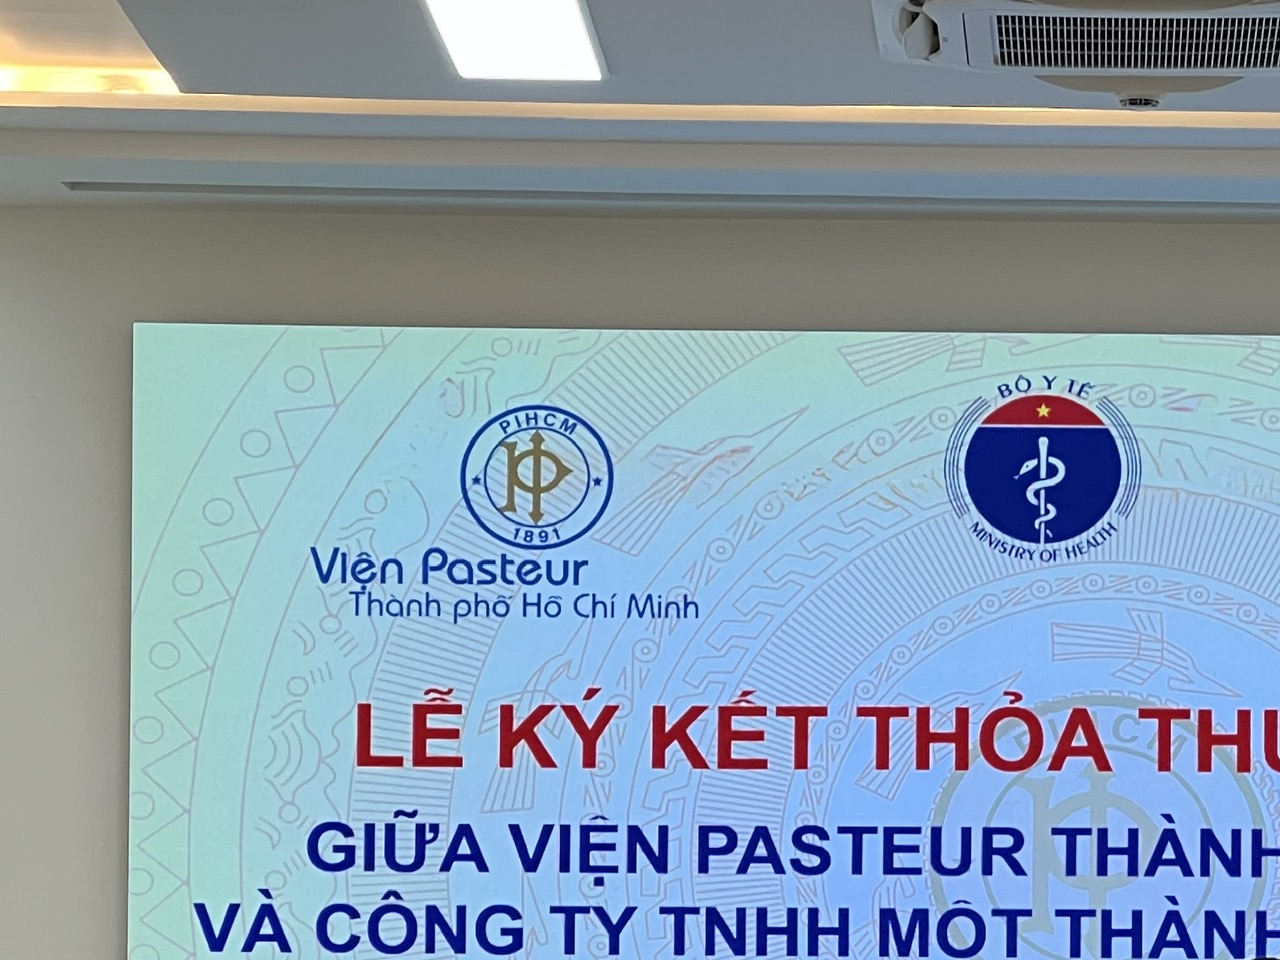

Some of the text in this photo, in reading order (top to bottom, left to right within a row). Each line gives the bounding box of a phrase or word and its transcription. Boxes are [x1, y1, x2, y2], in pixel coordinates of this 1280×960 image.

[1042, 375, 1057, 390] Y
[498, 412, 578, 435] PIHCM
[513, 527, 561, 543] 1891
[969, 521, 1118, 562] MINISTRY OF HEALTH
[421, 546, 589, 586] Pasteur
[349, 591, 441, 618] Thành
[453, 591, 512, 625] phố
[573, 592, 617, 619] Chí
[626, 592, 699, 619] Minh
[357, 688, 463, 768] LỄ
[499, 687, 620, 769] KÝ
[651, 689, 828, 770] KẾT
[857, 690, 1111, 772] THỎA
[306, 809, 490, 873] GIỮA
[508, 815, 669, 887] VIỆN
[697, 825, 1028, 877] PASTEUR
[193, 888, 292, 953] VÀ
[316, 890, 524, 956] CÔNG
[549, 905, 638, 956] TY
[659, 906, 850, 957] TNHH
